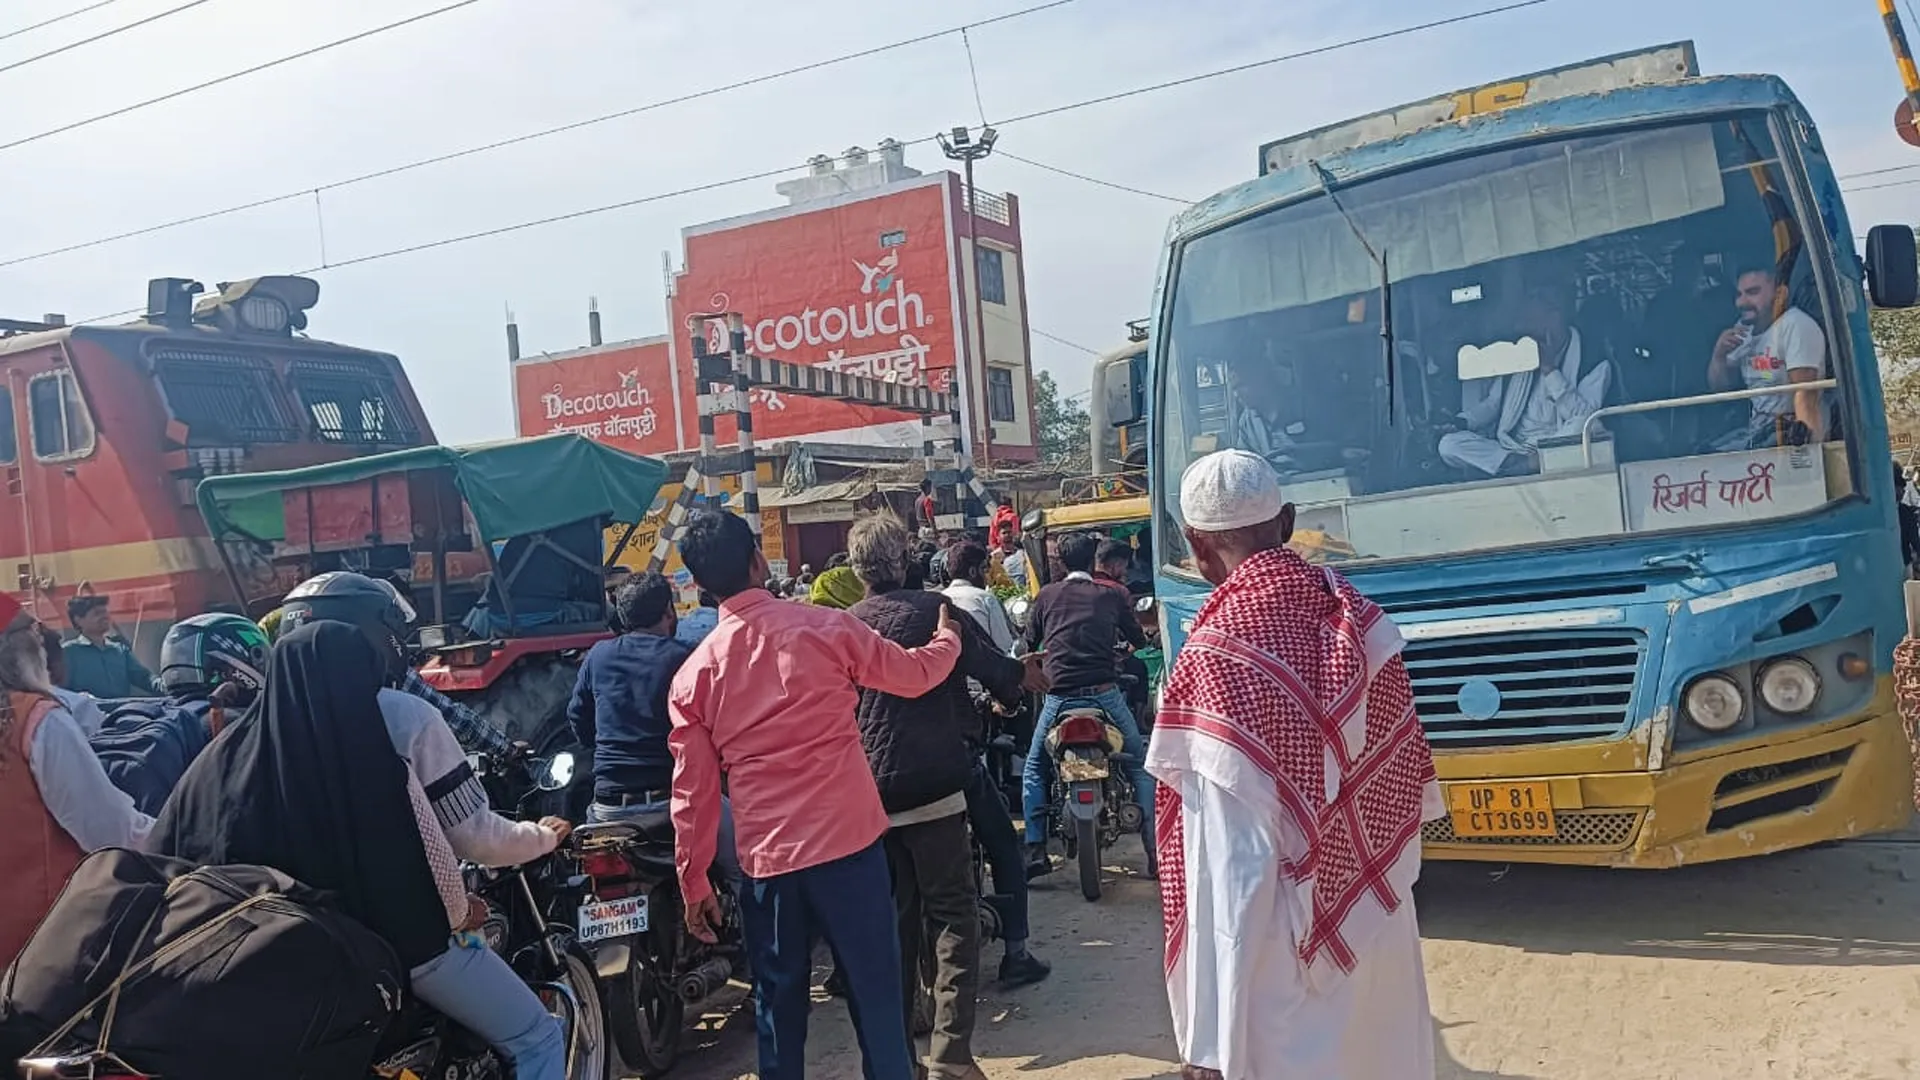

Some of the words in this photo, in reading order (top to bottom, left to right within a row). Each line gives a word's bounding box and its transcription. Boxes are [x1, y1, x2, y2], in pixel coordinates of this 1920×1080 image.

[541, 383, 649, 419] Decotouch
[1719, 462, 1775, 508] पार्टी
[1469, 788, 1494, 809] UP
[1510, 787, 1533, 808] 81
[1471, 811, 1548, 831] CT3699
